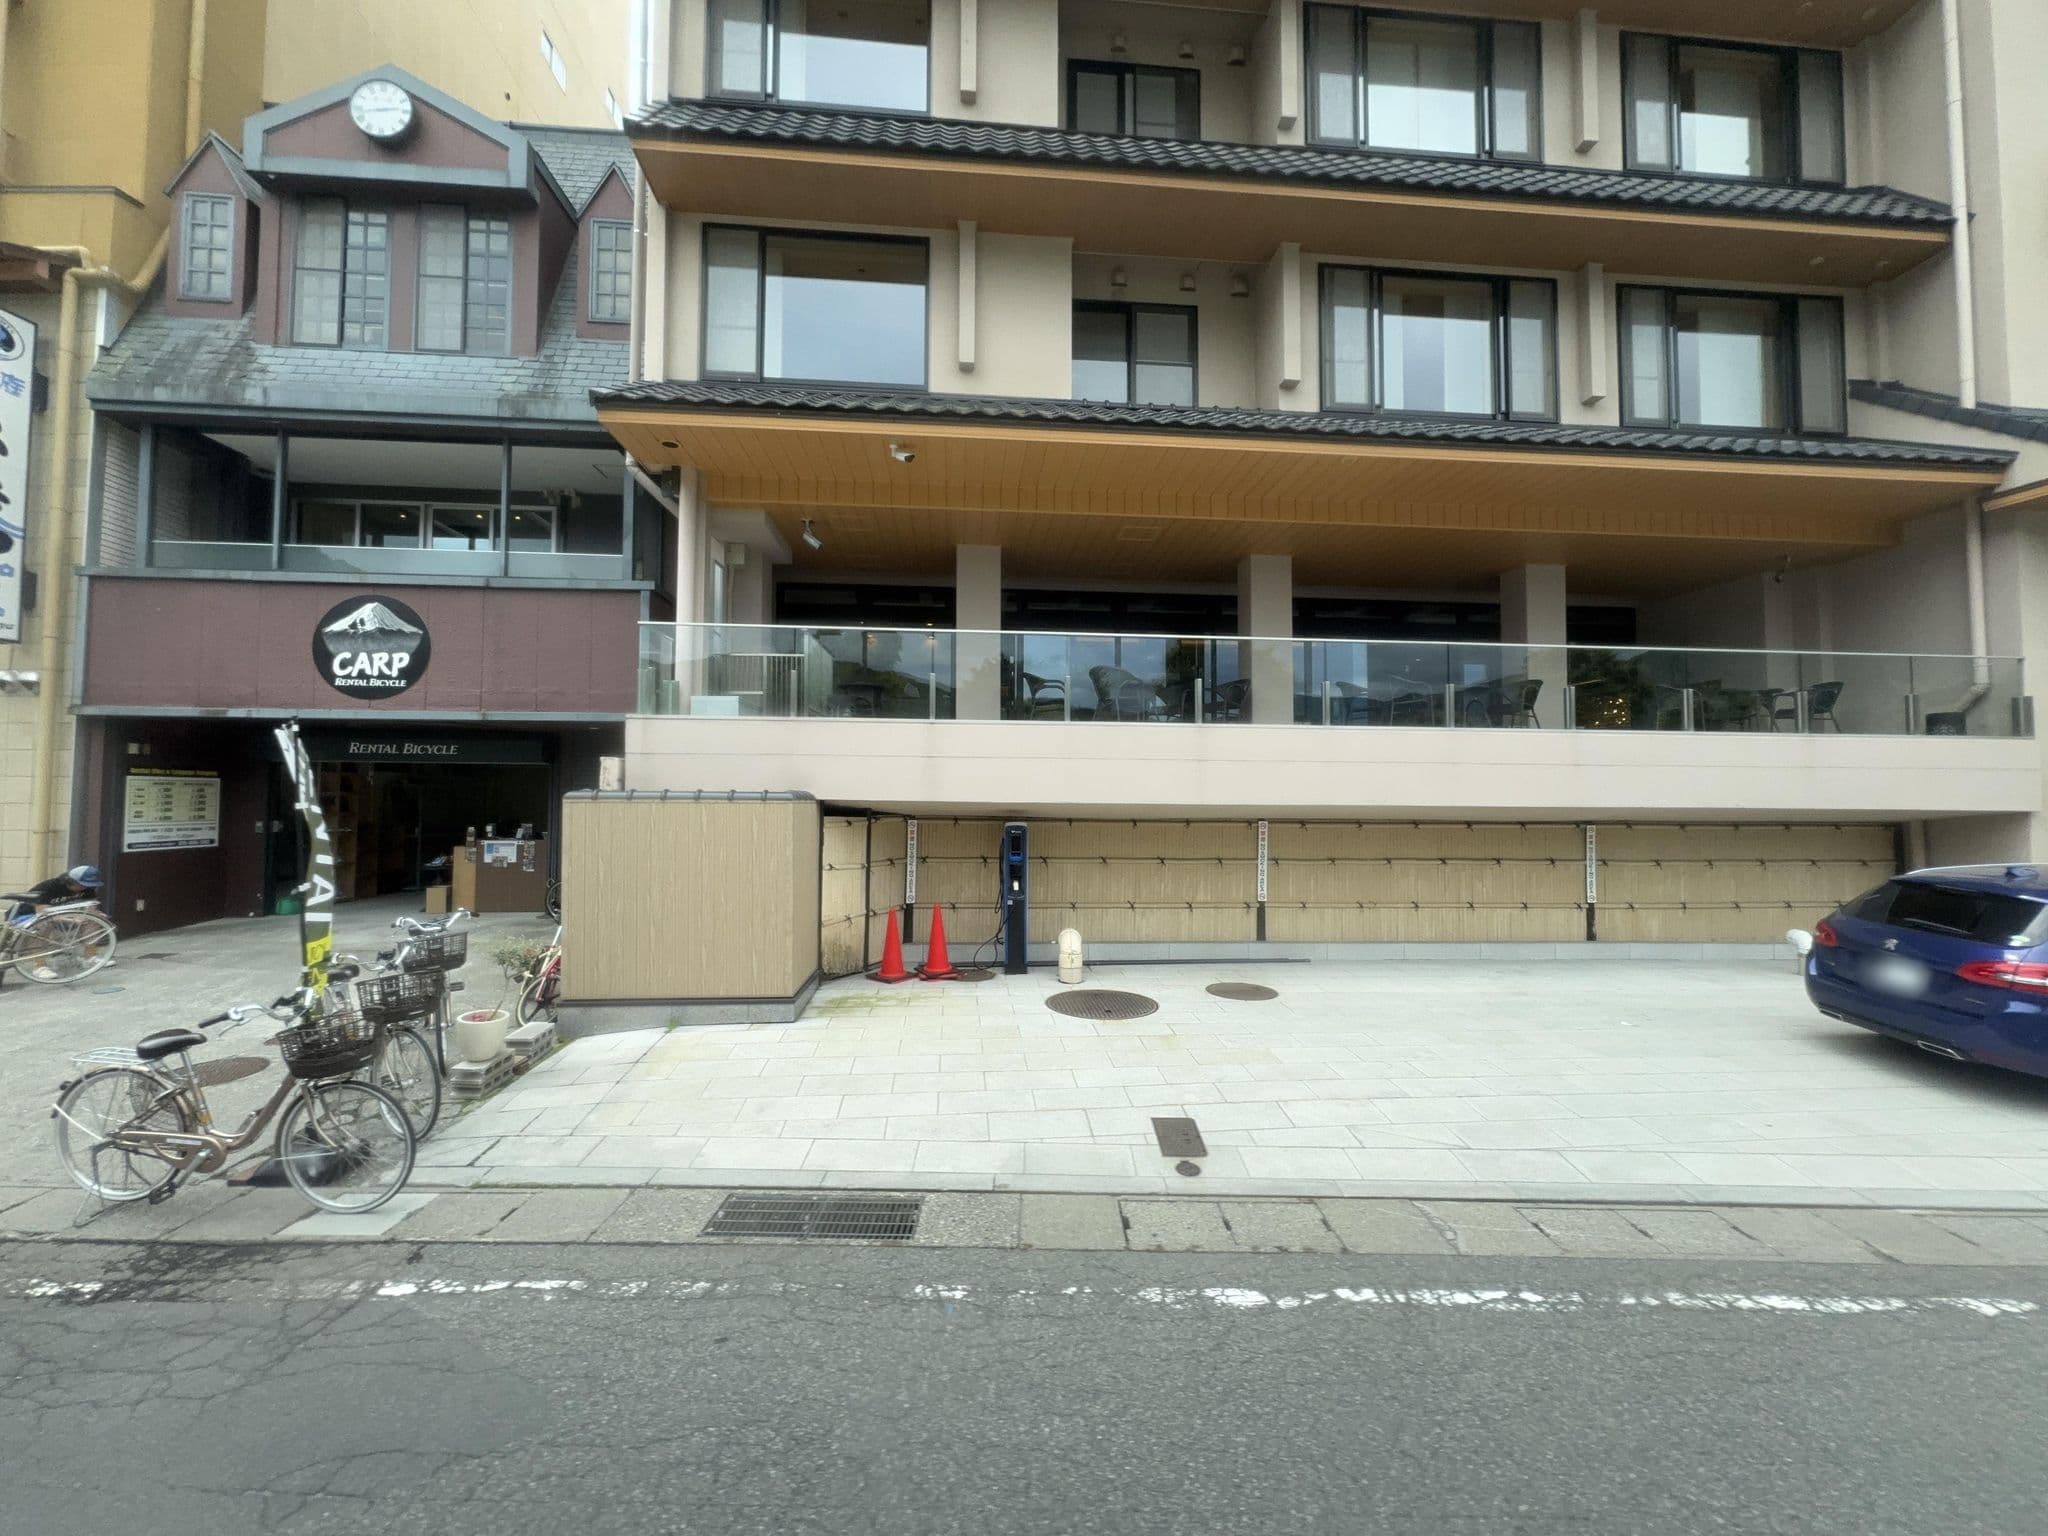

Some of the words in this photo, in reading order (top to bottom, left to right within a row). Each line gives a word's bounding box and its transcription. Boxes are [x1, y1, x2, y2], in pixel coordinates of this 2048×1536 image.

[332, 651, 410, 677] CARP
[335, 678, 368, 686] RENTAL
[369, 678, 407, 687] BICYCLE
[349, 742, 399, 754] RENTAL
[403, 743, 459, 755] BICYCLE
